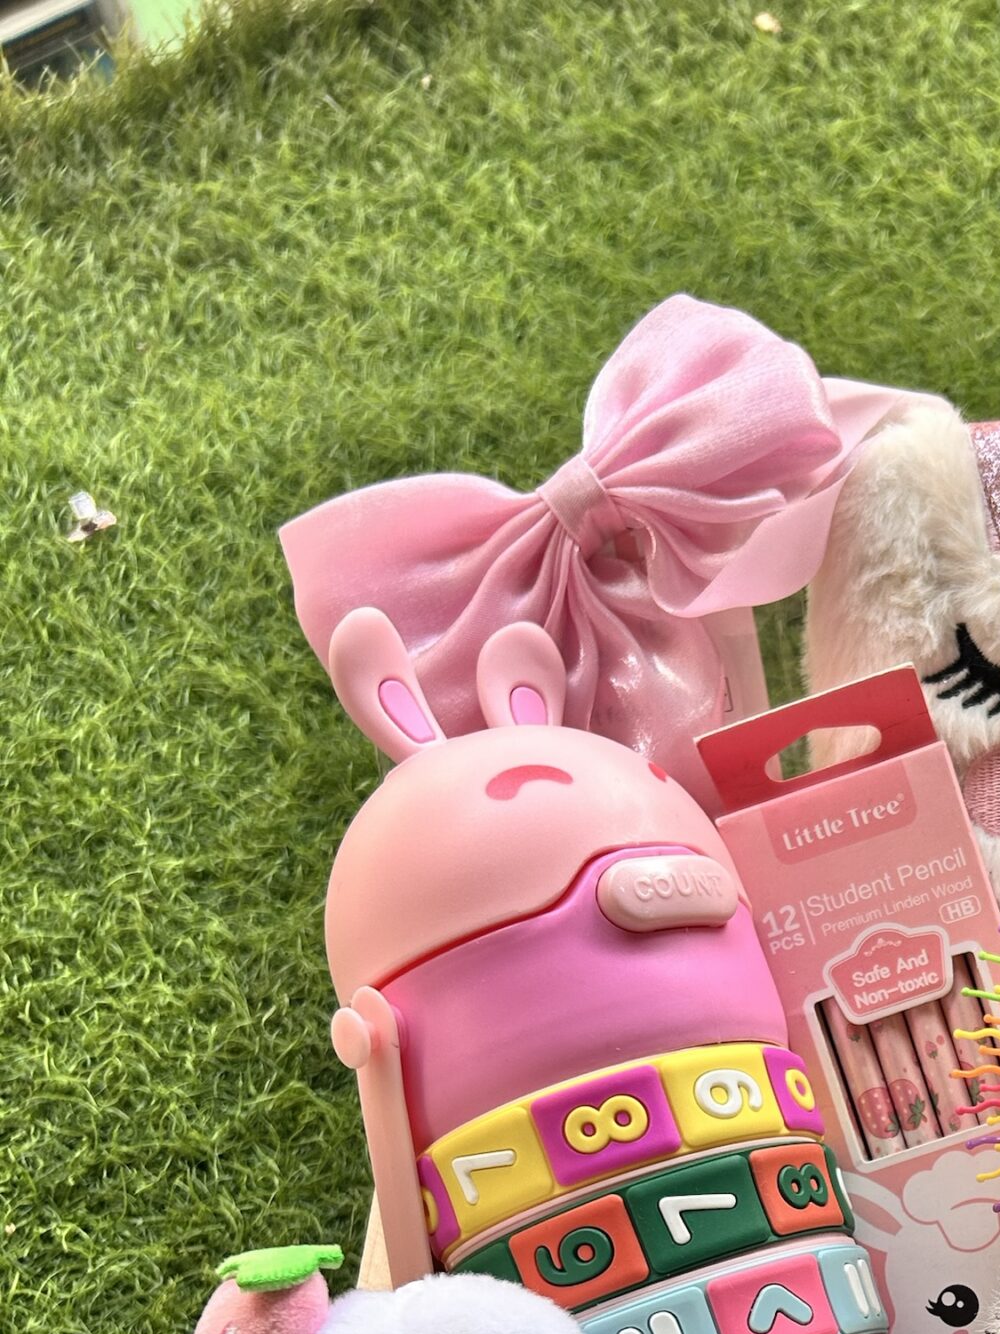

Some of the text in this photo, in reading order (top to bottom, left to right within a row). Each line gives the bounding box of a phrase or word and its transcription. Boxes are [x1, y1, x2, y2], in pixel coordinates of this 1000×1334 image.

[782, 815, 845, 851] Little
[633, 871, 723, 902] COUNT
[806, 847, 967, 917] Student Pencil
[761, 904, 801, 938] 12
[821, 876, 973, 936] Premium Linden Wood
[947, 899, 976, 920] HB
[769, 932, 806, 955] PCS
[852, 949, 929, 987] Safe And
[853, 969, 940, 1009] Non-toxic
